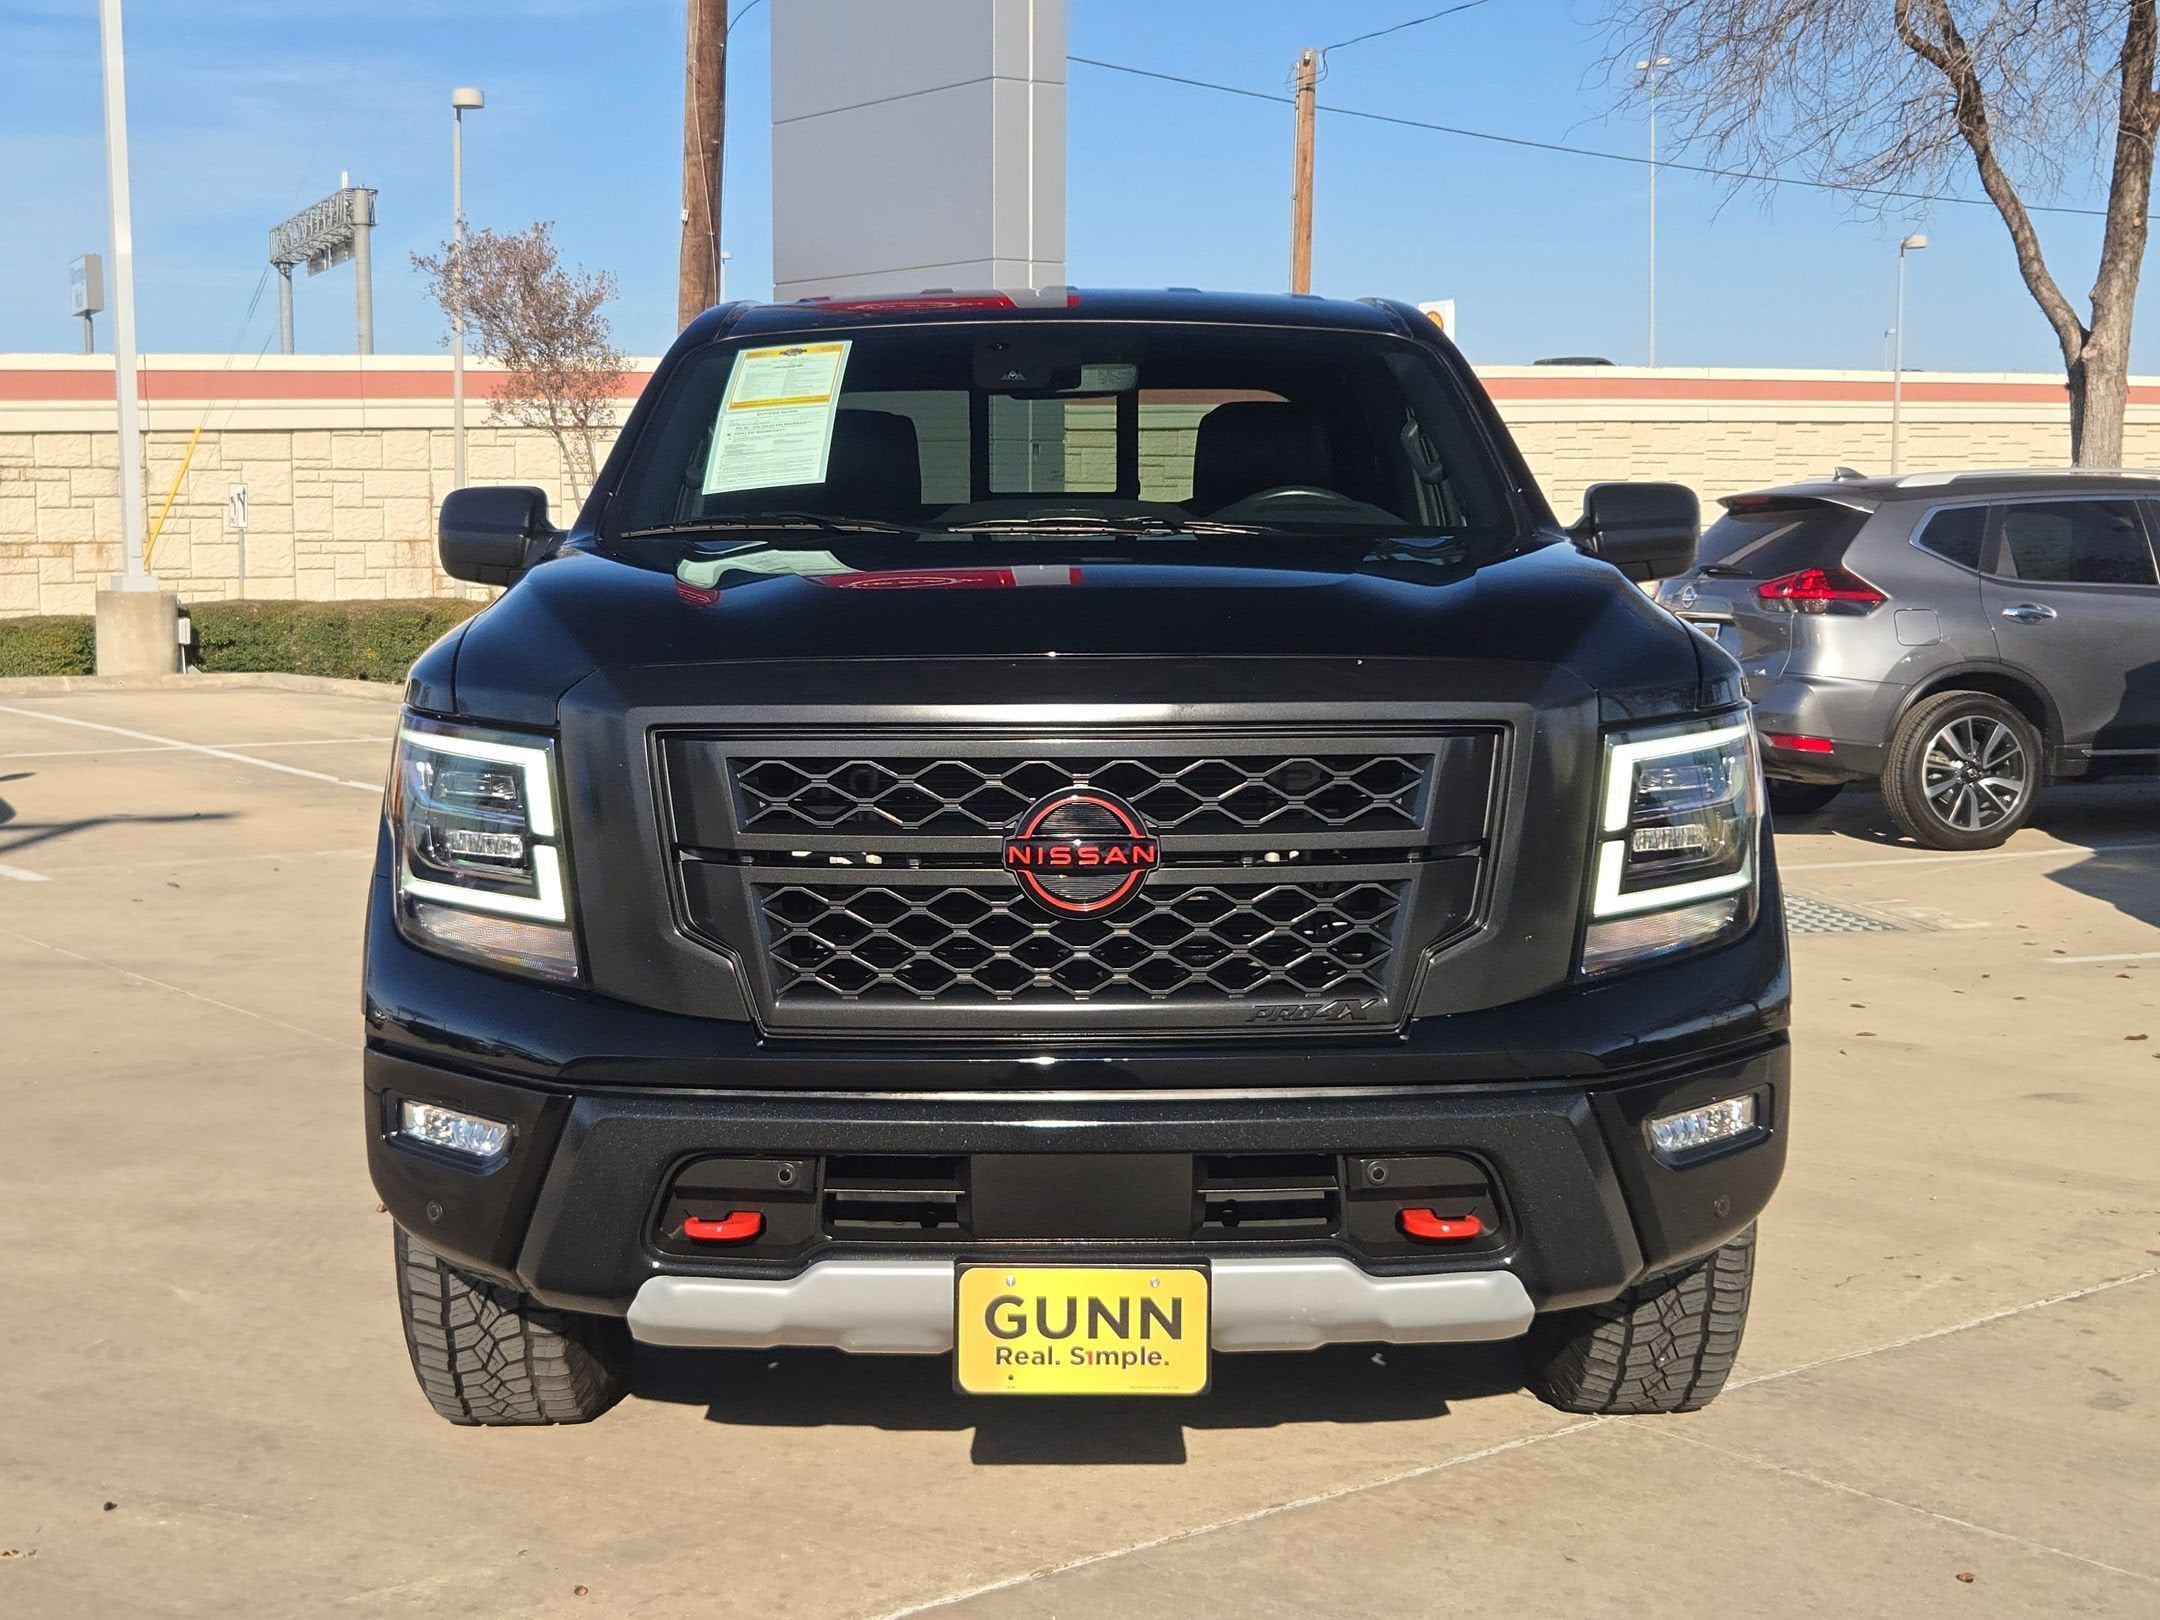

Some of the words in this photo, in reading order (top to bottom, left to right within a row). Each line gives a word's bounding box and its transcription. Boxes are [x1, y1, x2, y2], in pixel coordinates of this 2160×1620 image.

[1008, 846, 1155, 865] NISSAN
[984, 1294, 1182, 1340] GUNN
[996, 1346, 1061, 1366] Real.
